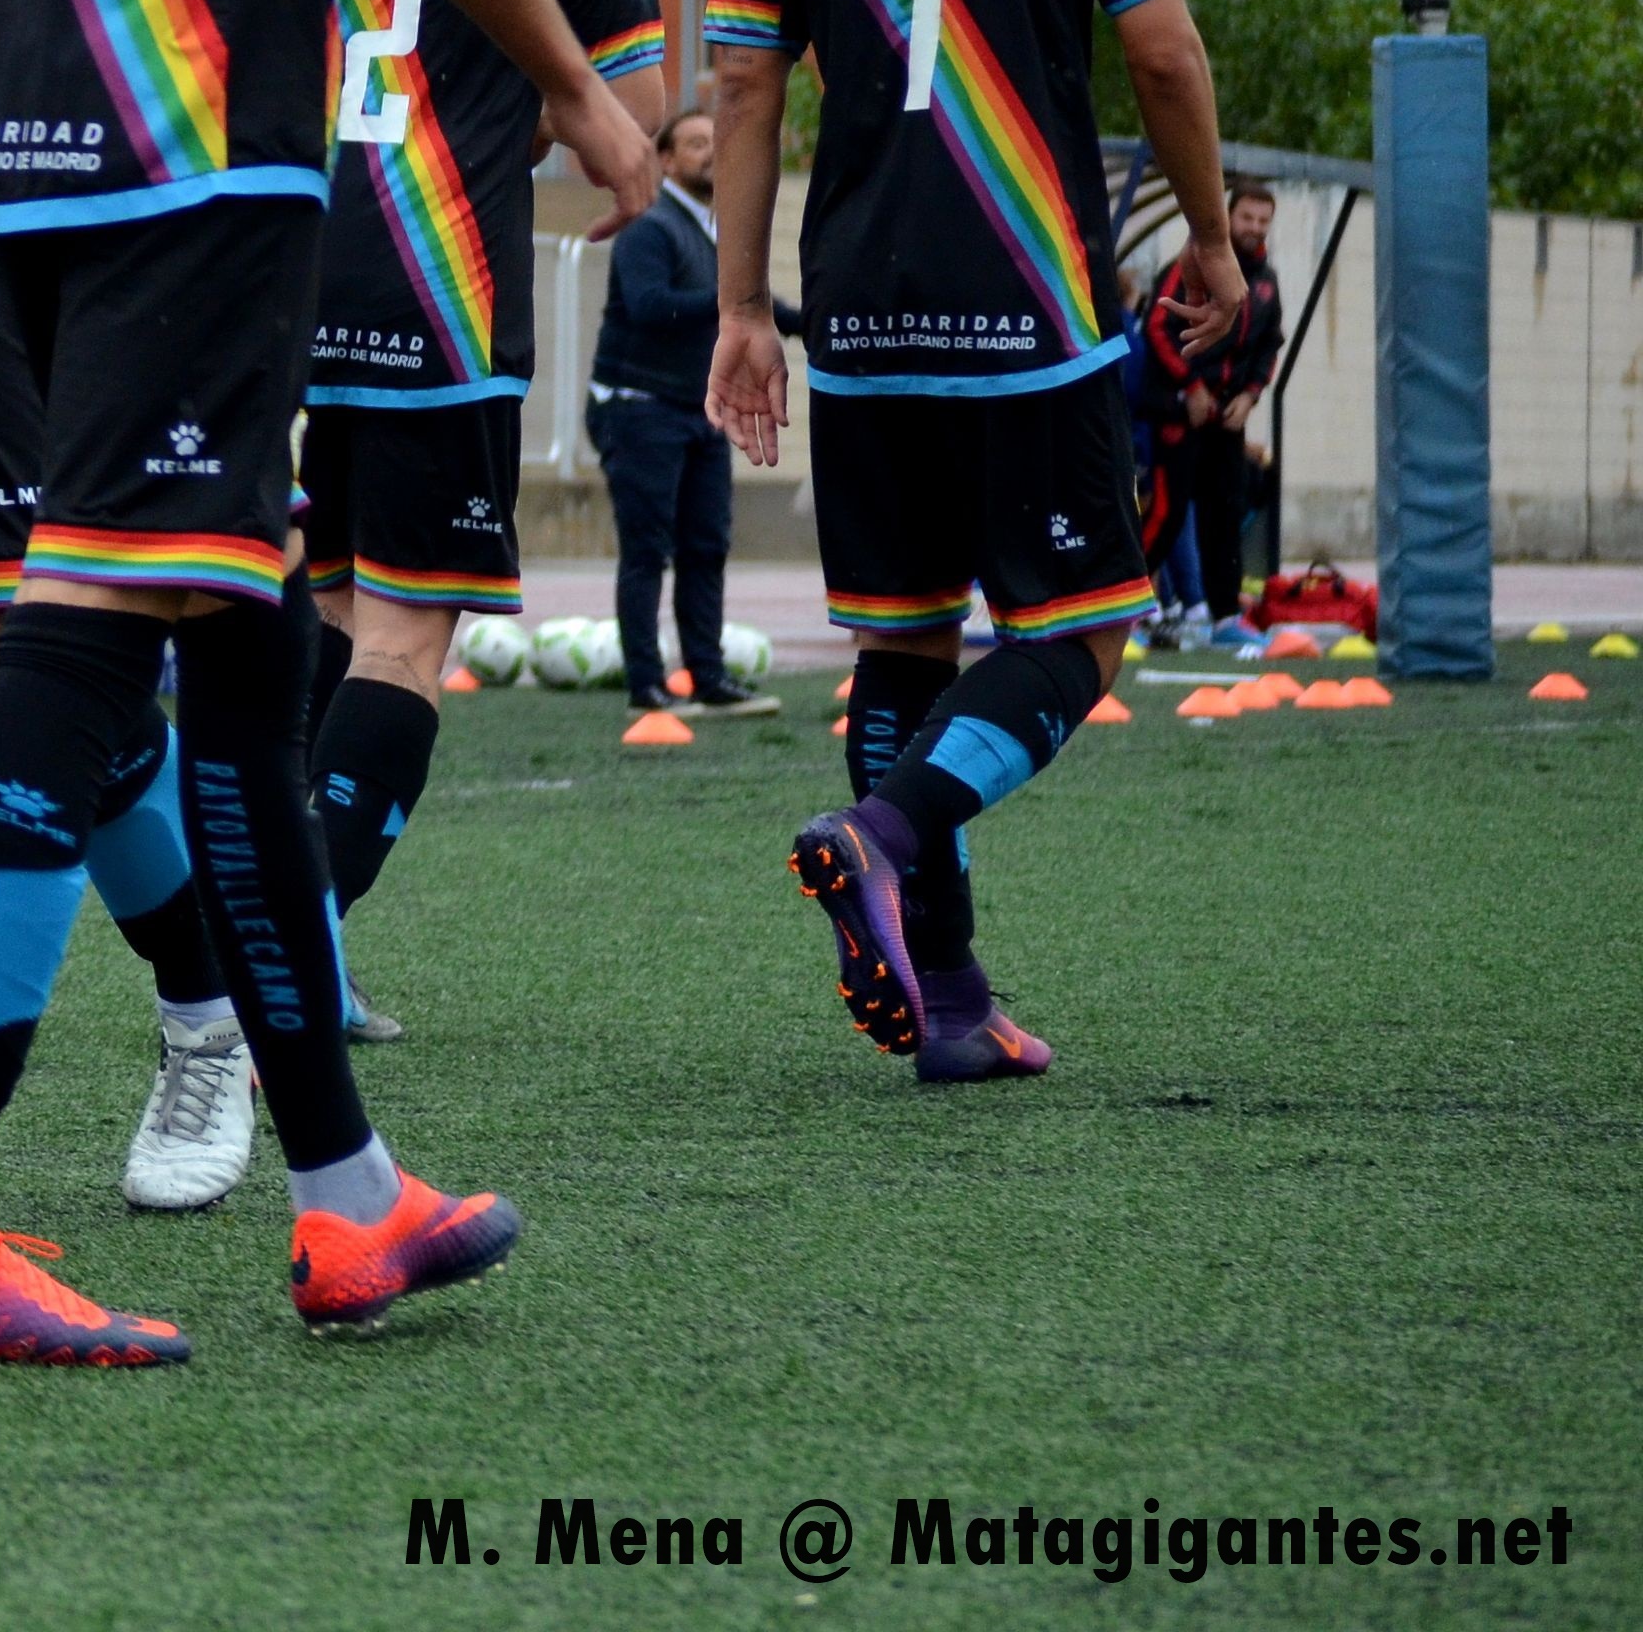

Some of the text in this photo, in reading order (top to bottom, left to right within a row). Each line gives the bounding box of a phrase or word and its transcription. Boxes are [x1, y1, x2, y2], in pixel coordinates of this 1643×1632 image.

[830, 313, 1035, 333] SOLIDARIDAD
[831, 333, 1036, 350] RAYO VALLECANO DE MADRID
[350, 348, 368, 361] DE
[369, 350, 423, 369] MADRID
[146, 459, 221, 474] KELME
[452, 518, 503, 533] KELME
[1052, 535, 1086, 551] LME
